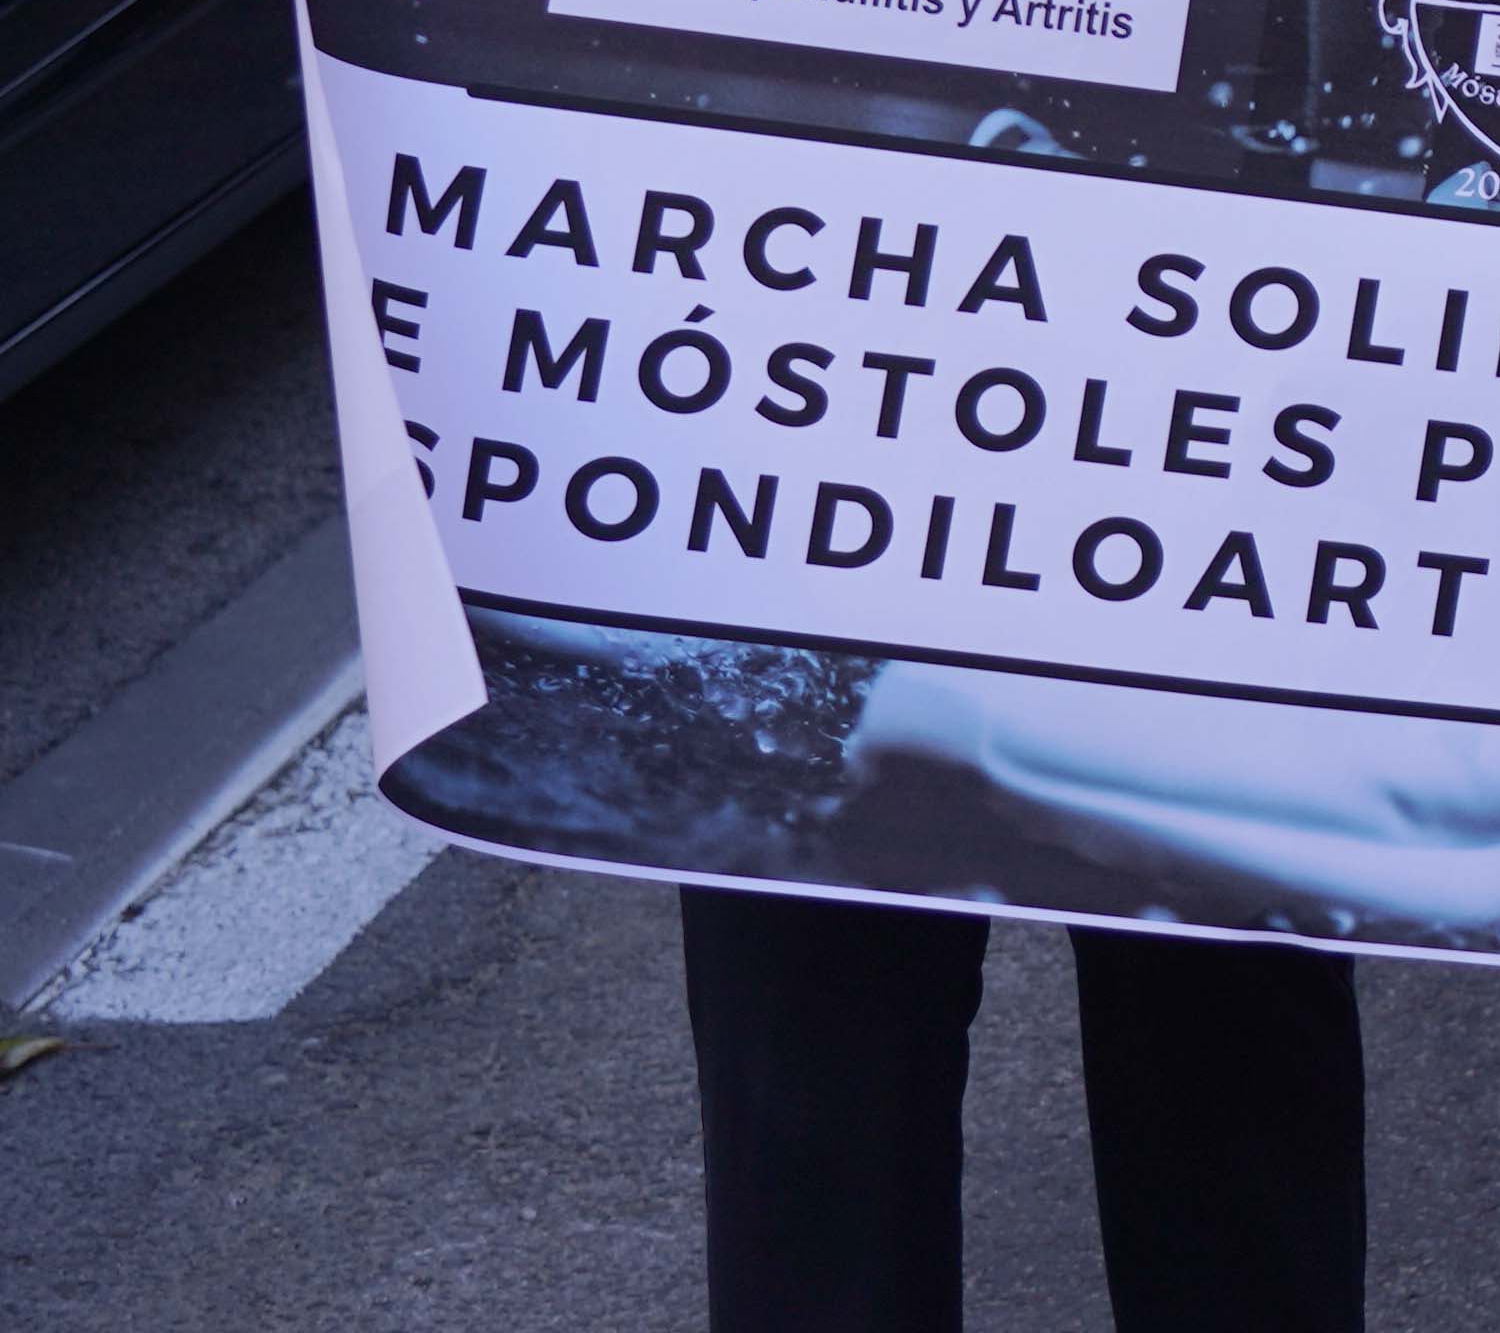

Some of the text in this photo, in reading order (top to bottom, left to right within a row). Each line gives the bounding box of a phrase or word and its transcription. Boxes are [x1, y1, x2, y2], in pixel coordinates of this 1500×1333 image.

[385, 152, 1048, 324] MARCHA
[371, 277, 429, 374] E
[501, 304, 1342, 489] MÓSTOLES
